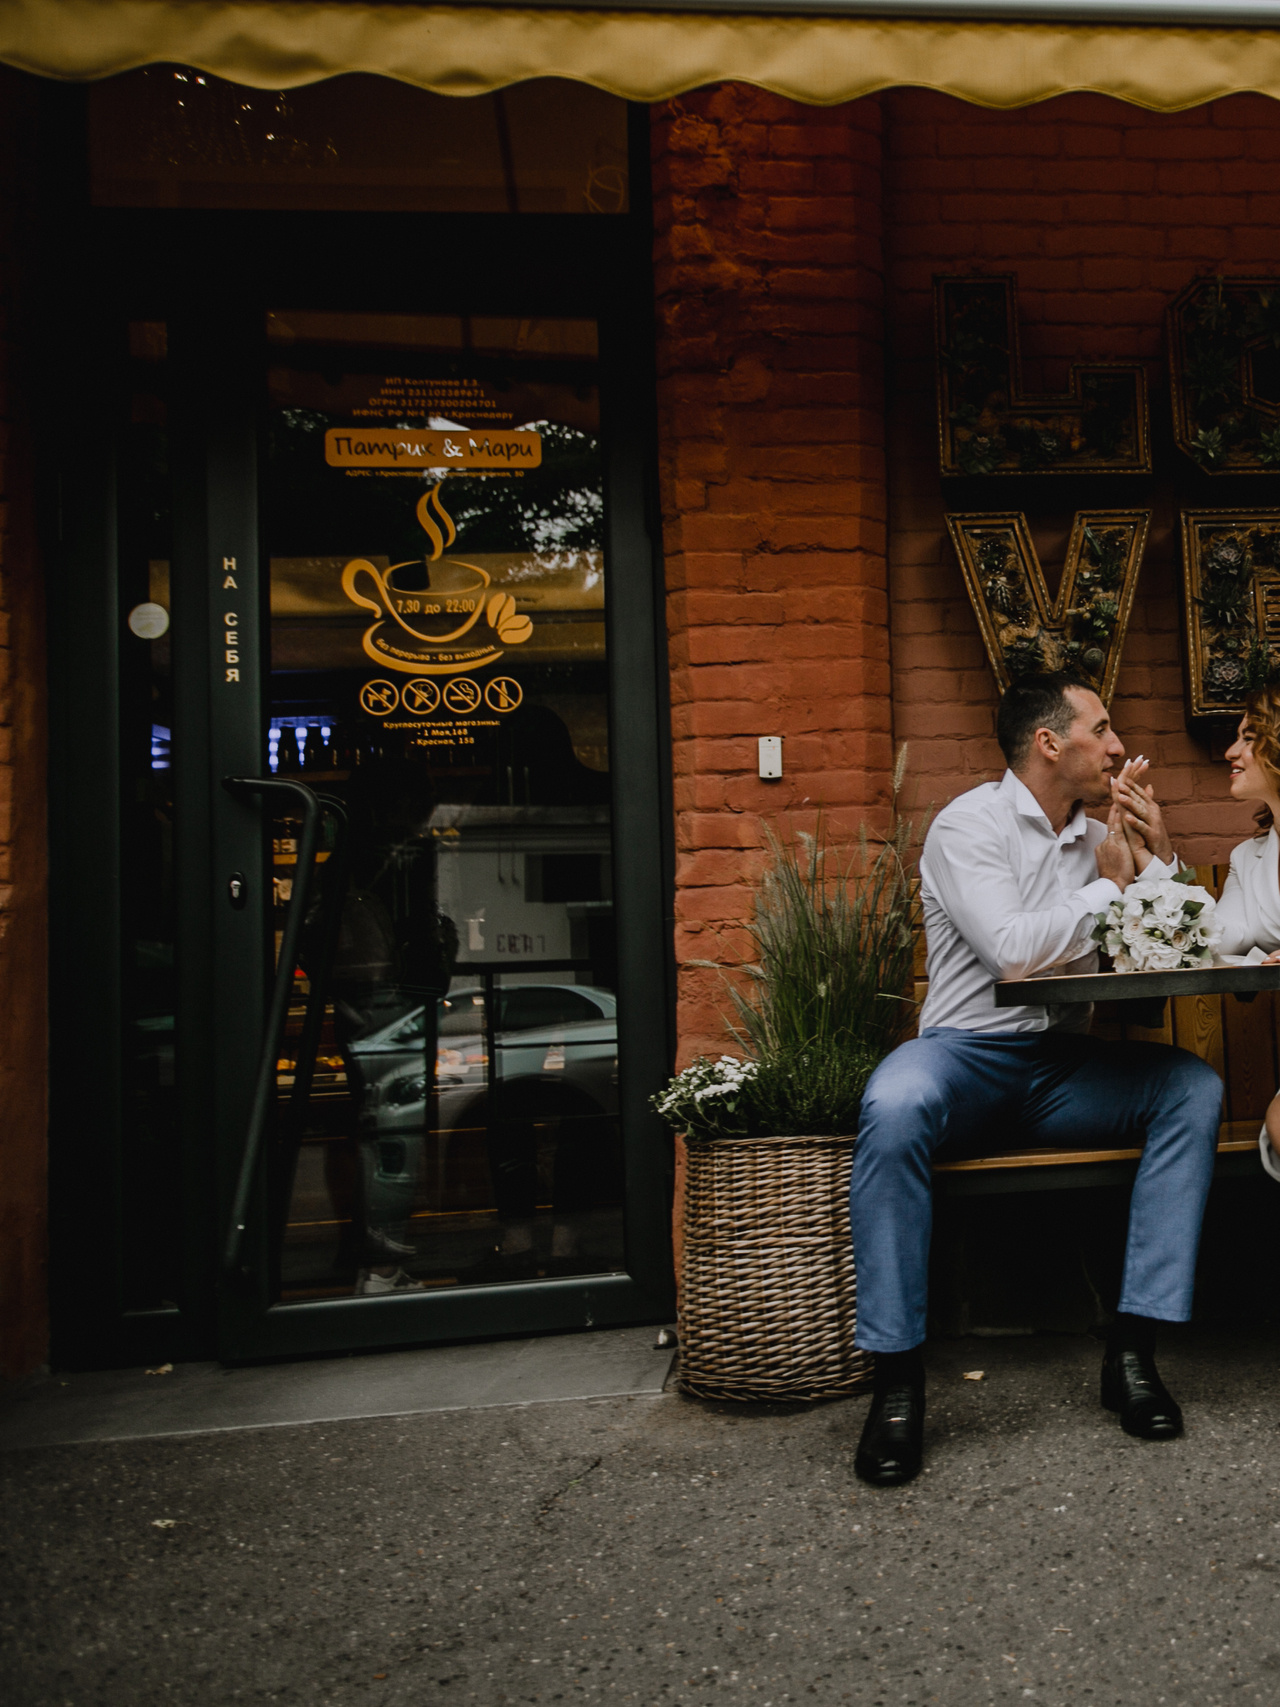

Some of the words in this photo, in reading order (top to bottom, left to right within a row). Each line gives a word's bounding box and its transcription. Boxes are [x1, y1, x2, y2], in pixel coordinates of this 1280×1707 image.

[380, 387, 405, 396] ИНН
[408, 388, 485, 398] 231102389671
[368, 397, 398, 407] ОГРН
[401, 398, 497, 408] 317237500204701
[334, 436, 437, 461] Патрик
[442, 438, 464, 458] &
[469, 437, 534, 461] Мари
[222, 556, 238, 590] НА
[396, 599, 420, 614] 7.30
[424, 603, 441, 615] до
[446, 599, 475, 614] 22:00
[224, 612, 240, 682] СЕБЯ
[438, 652, 453, 662] без
[454, 644, 496, 660] выходных
